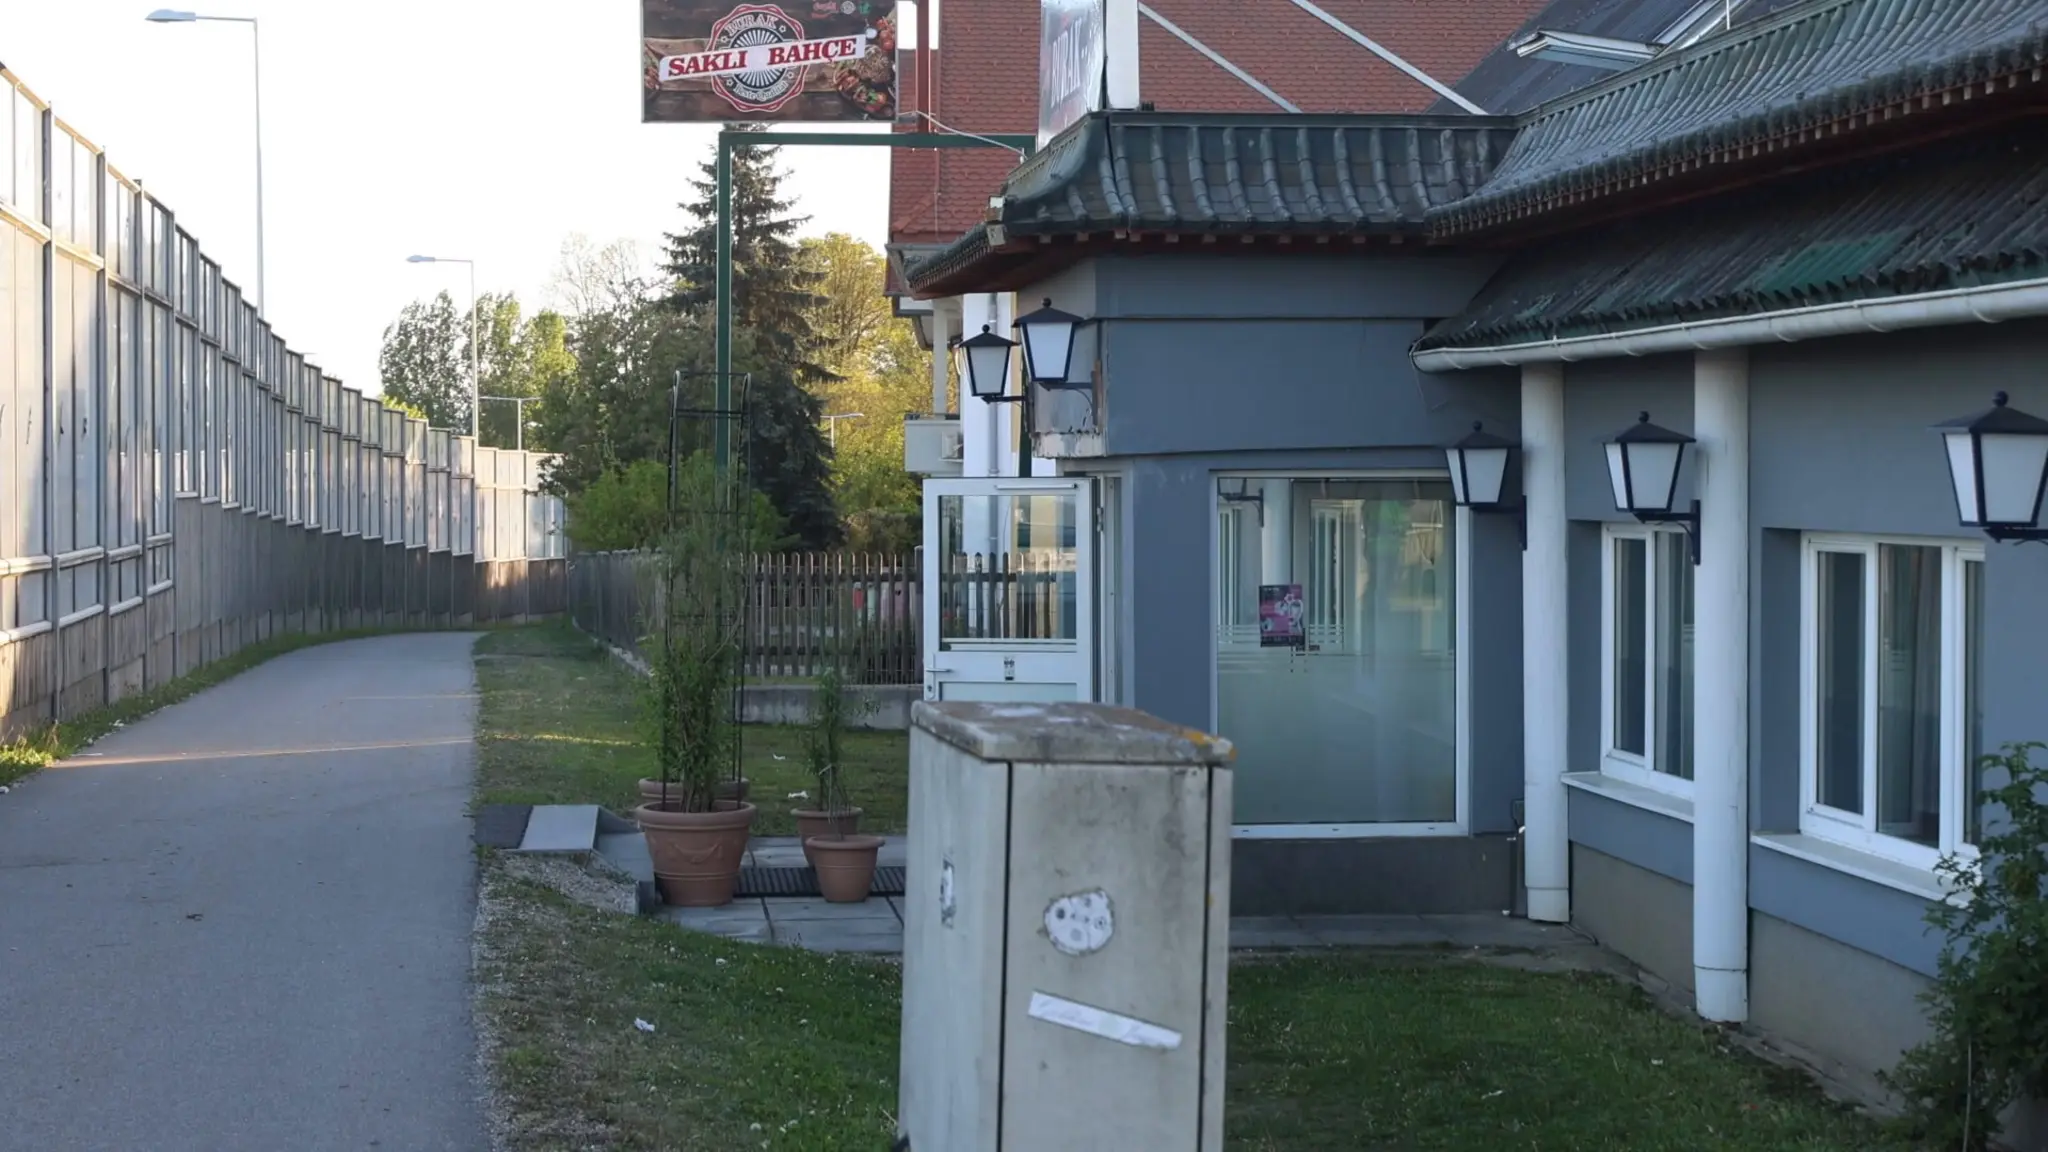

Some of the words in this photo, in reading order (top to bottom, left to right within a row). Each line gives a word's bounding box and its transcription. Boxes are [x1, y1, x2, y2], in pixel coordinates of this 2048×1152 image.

[724, 13, 779, 36] BURAK
[668, 50, 747, 78] SAKLI
[768, 38, 857, 66] BAHÇE
